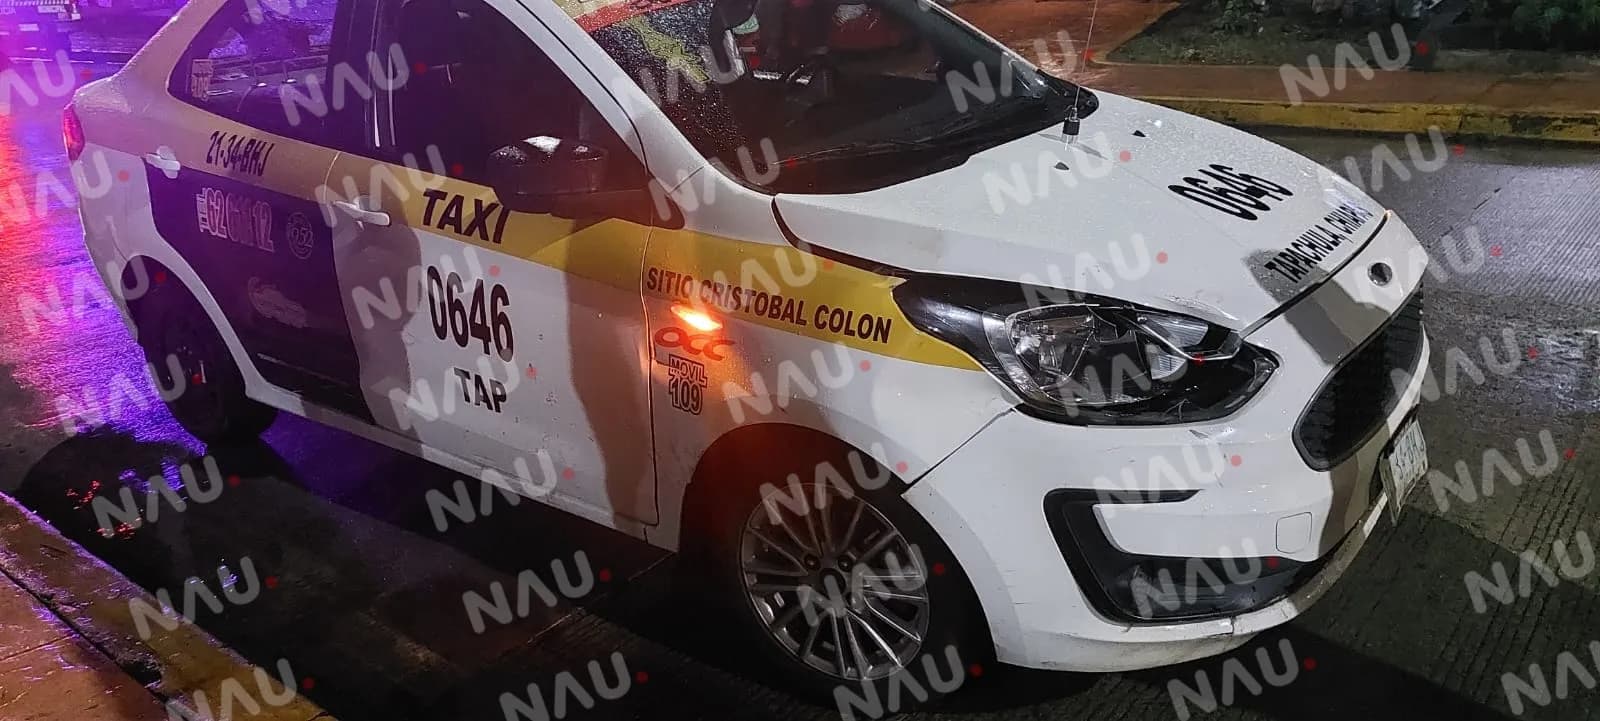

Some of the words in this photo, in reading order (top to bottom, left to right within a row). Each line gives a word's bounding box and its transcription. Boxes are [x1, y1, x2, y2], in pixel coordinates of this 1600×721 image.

[422, 187, 512, 245] TAXI
[1167, 163, 1294, 221] 0646
[426, 265, 515, 363] 0646
[646, 266, 695, 300] SITIO
[700, 279, 808, 327] CRISTOBAL
[813, 304, 893, 344] COLON
[453, 366, 507, 414] TAP
[671, 377, 701, 413] 109
